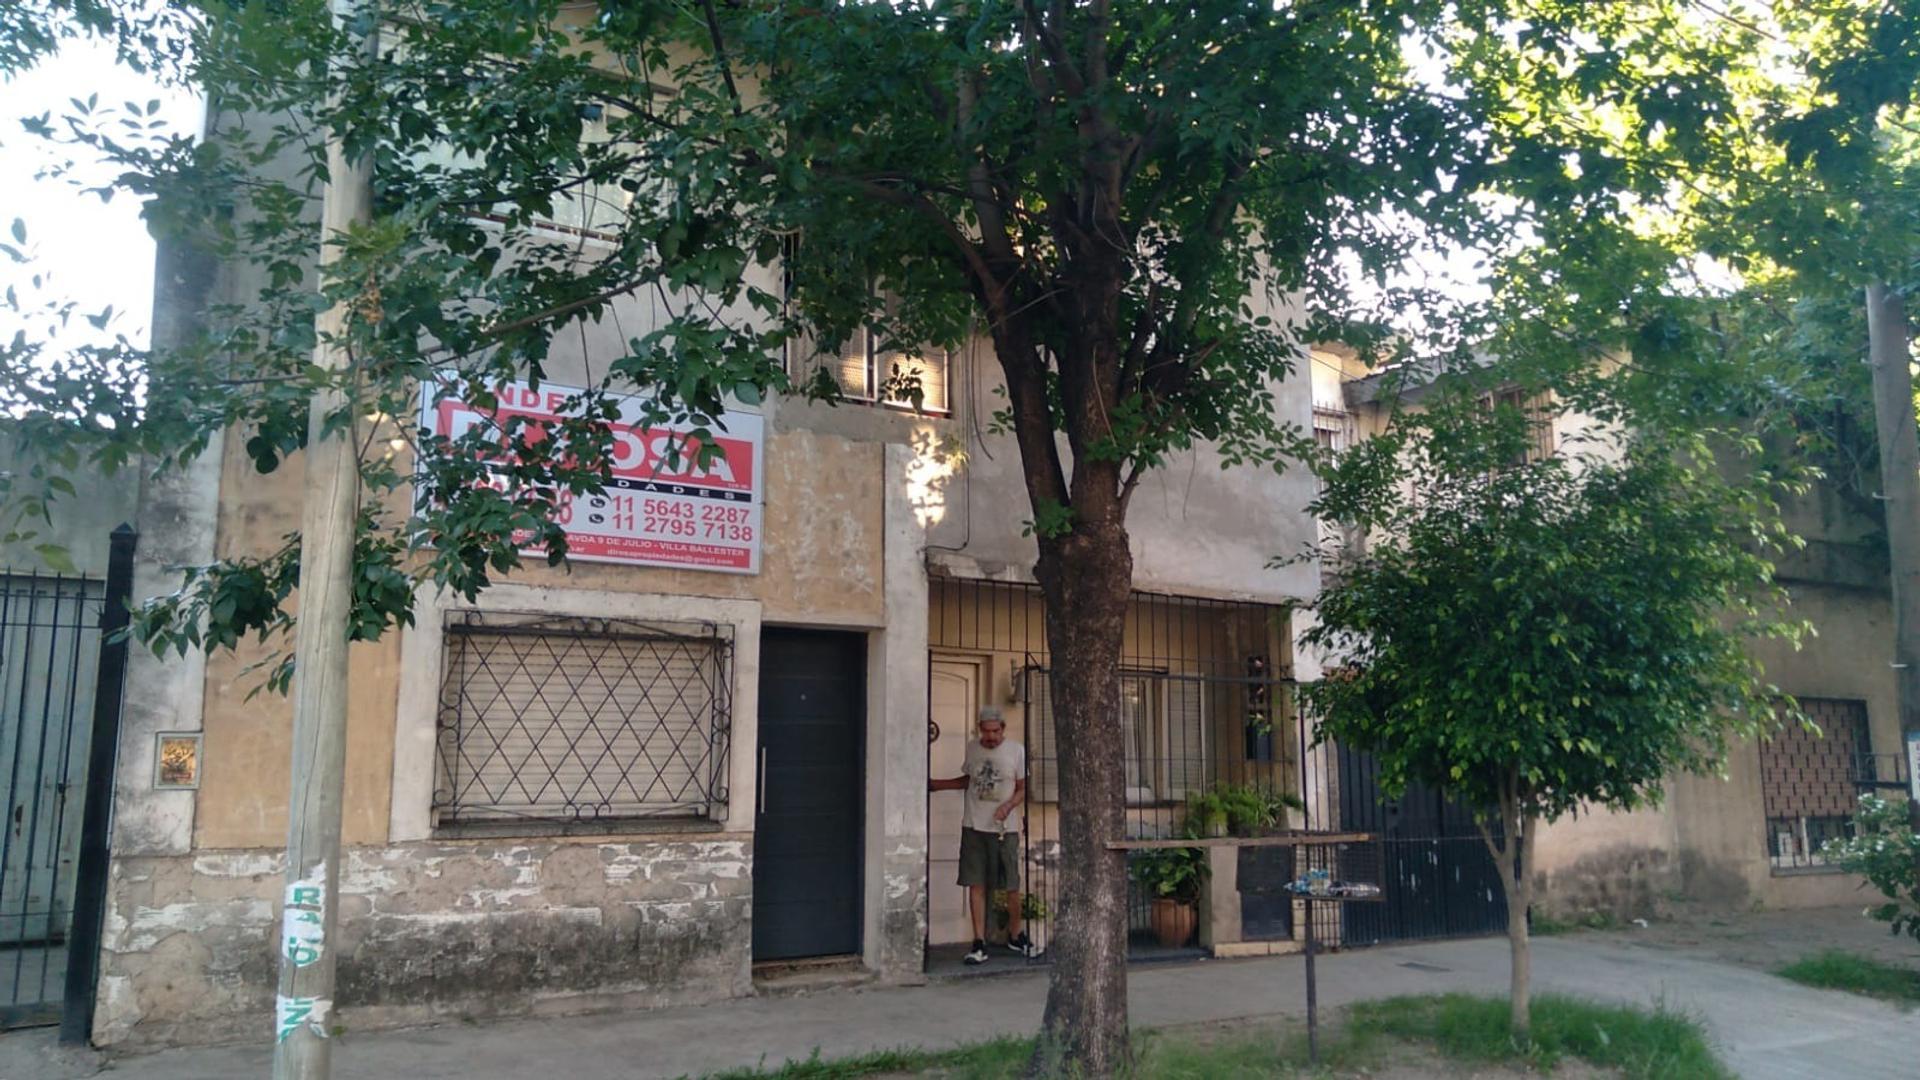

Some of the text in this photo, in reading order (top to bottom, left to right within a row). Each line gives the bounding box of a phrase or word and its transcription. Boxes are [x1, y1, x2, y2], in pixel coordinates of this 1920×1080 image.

[612, 495, 750, 524] 11 5643 2287
[612, 513, 753, 542] 11 2795 7138
[606, 538, 621, 546] DE
[622, 539, 651, 549] JULIO
[659, 542, 688, 552] VILLA
[688, 544, 745, 557] BALLESTER
